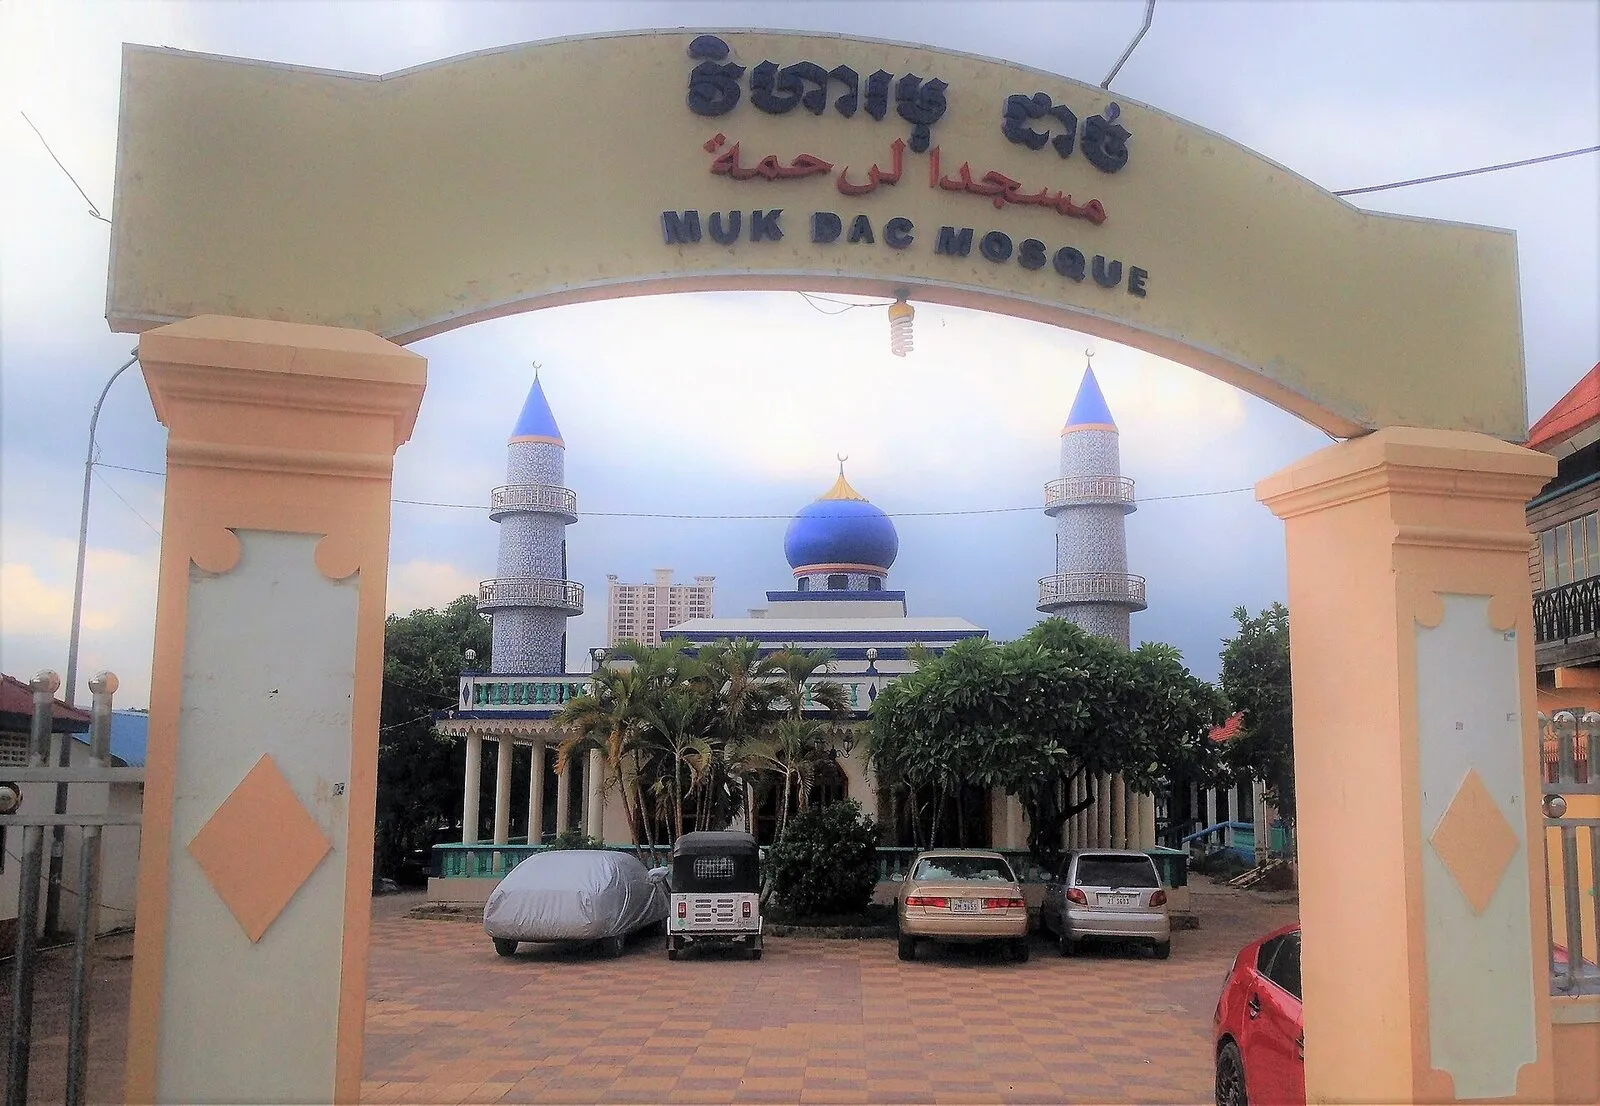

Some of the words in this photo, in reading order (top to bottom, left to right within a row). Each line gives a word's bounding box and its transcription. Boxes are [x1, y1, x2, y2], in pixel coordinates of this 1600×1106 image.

[661, 208, 784, 245] MUK
[810, 210, 915, 250] DAC
[934, 225, 1150, 298] MOSQUE
